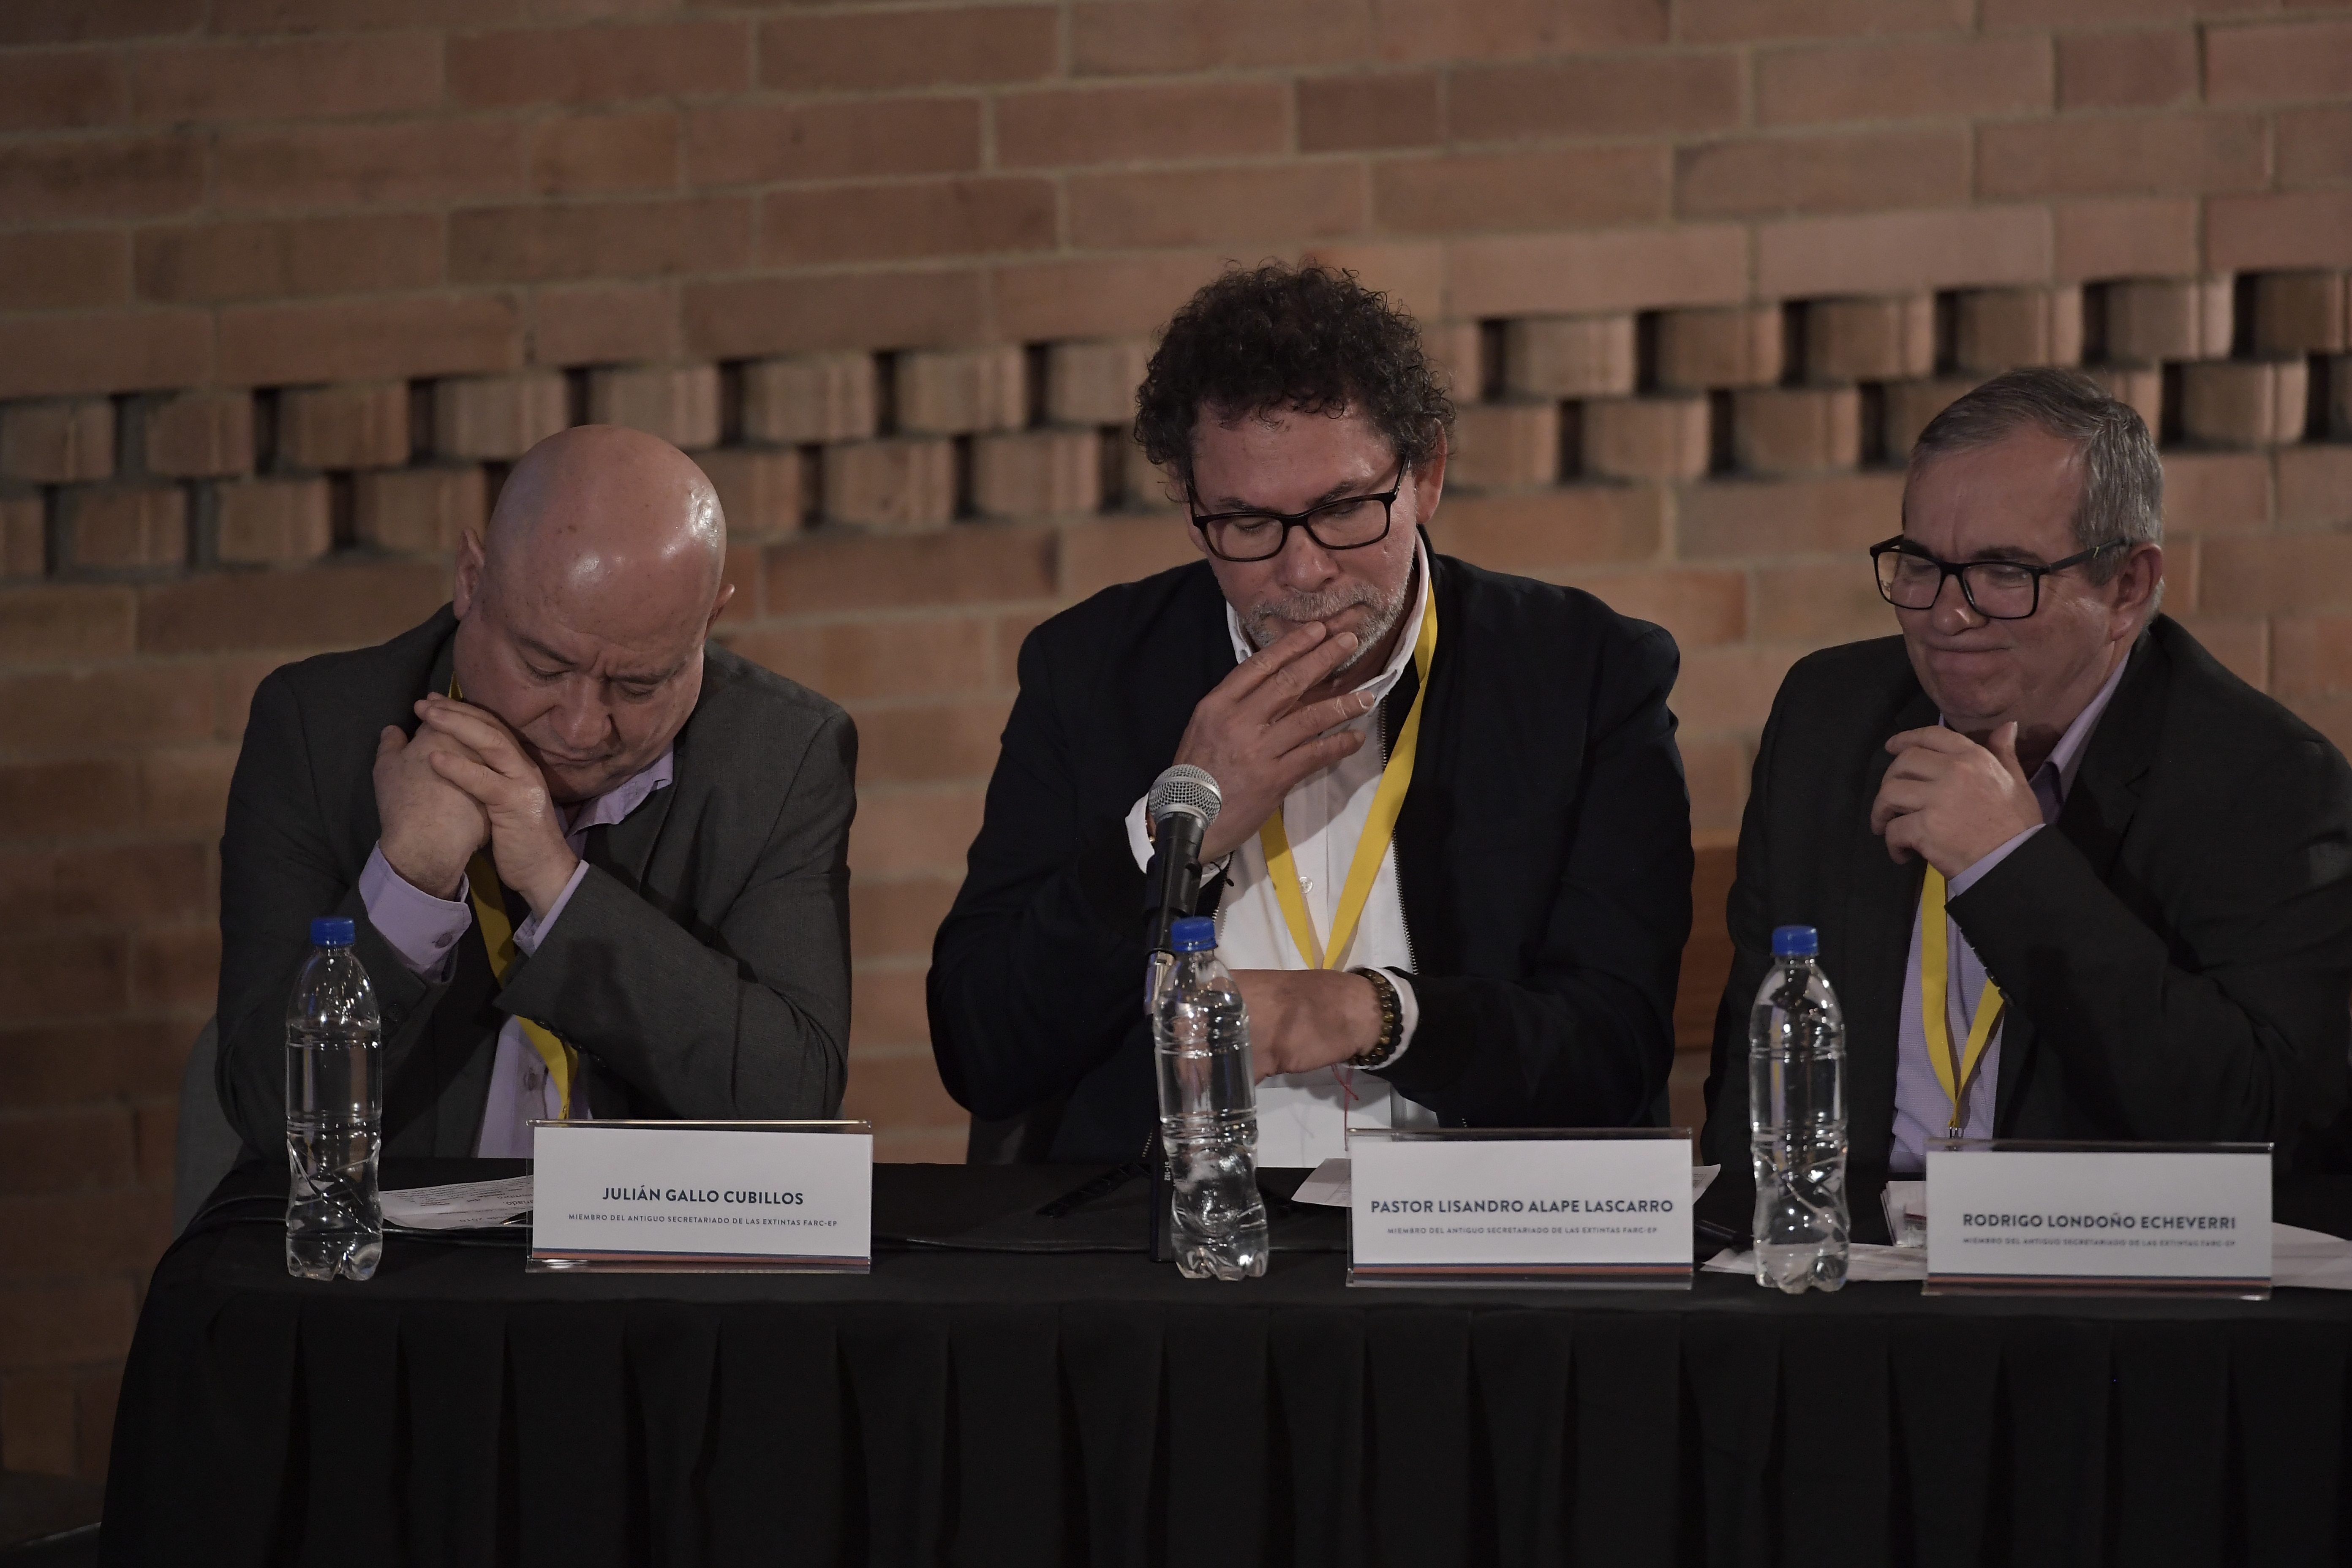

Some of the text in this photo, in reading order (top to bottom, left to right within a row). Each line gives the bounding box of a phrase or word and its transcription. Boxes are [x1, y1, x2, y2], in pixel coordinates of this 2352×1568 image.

[602, 1185, 803, 1206] JULIÁN GALLO CUBILLOS
[1371, 1199, 1674, 1213] PASTOR LISANDRO ALAPE LASCARRO
[568, 1213, 607, 1221] MIEMBRO
[667, 1216, 730, 1224] SECRETARIADO
[1963, 1212, 2235, 1230] RODRIGO LONDOÑO ECHEVERRI
